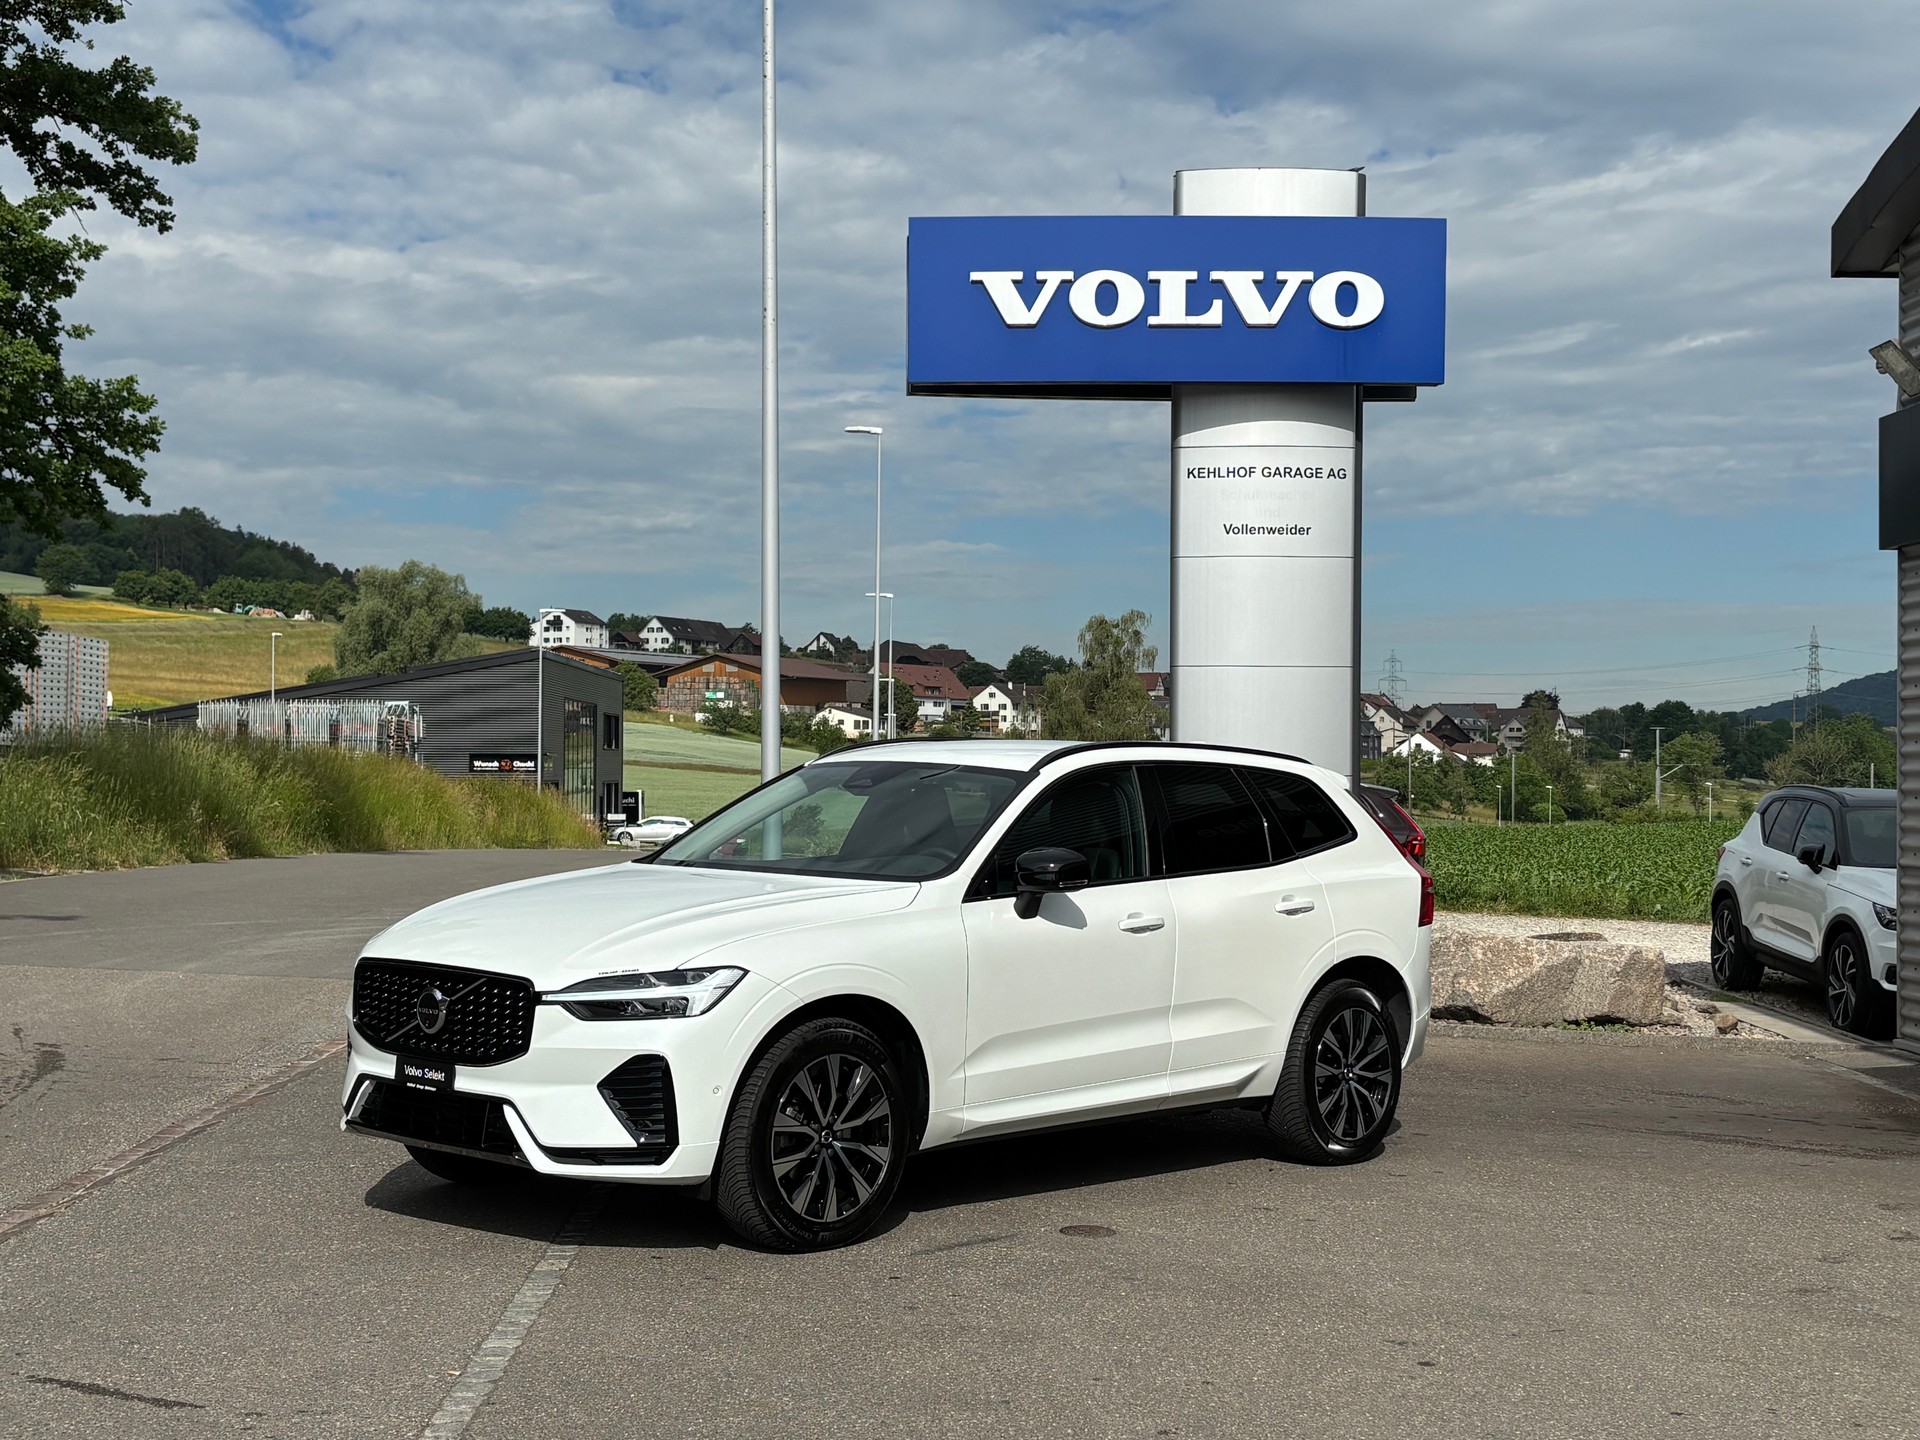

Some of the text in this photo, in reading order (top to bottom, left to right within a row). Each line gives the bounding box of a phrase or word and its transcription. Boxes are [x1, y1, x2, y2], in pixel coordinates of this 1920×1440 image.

[970, 269, 1385, 329] VOLVO
[1187, 466, 1348, 480] KEHLHOF GARAGE AG
[1223, 523, 1312, 536] Vollenweider
[418, 1006, 439, 1015] VOLVO
[404, 1064, 446, 1082] Volvo Selekt
